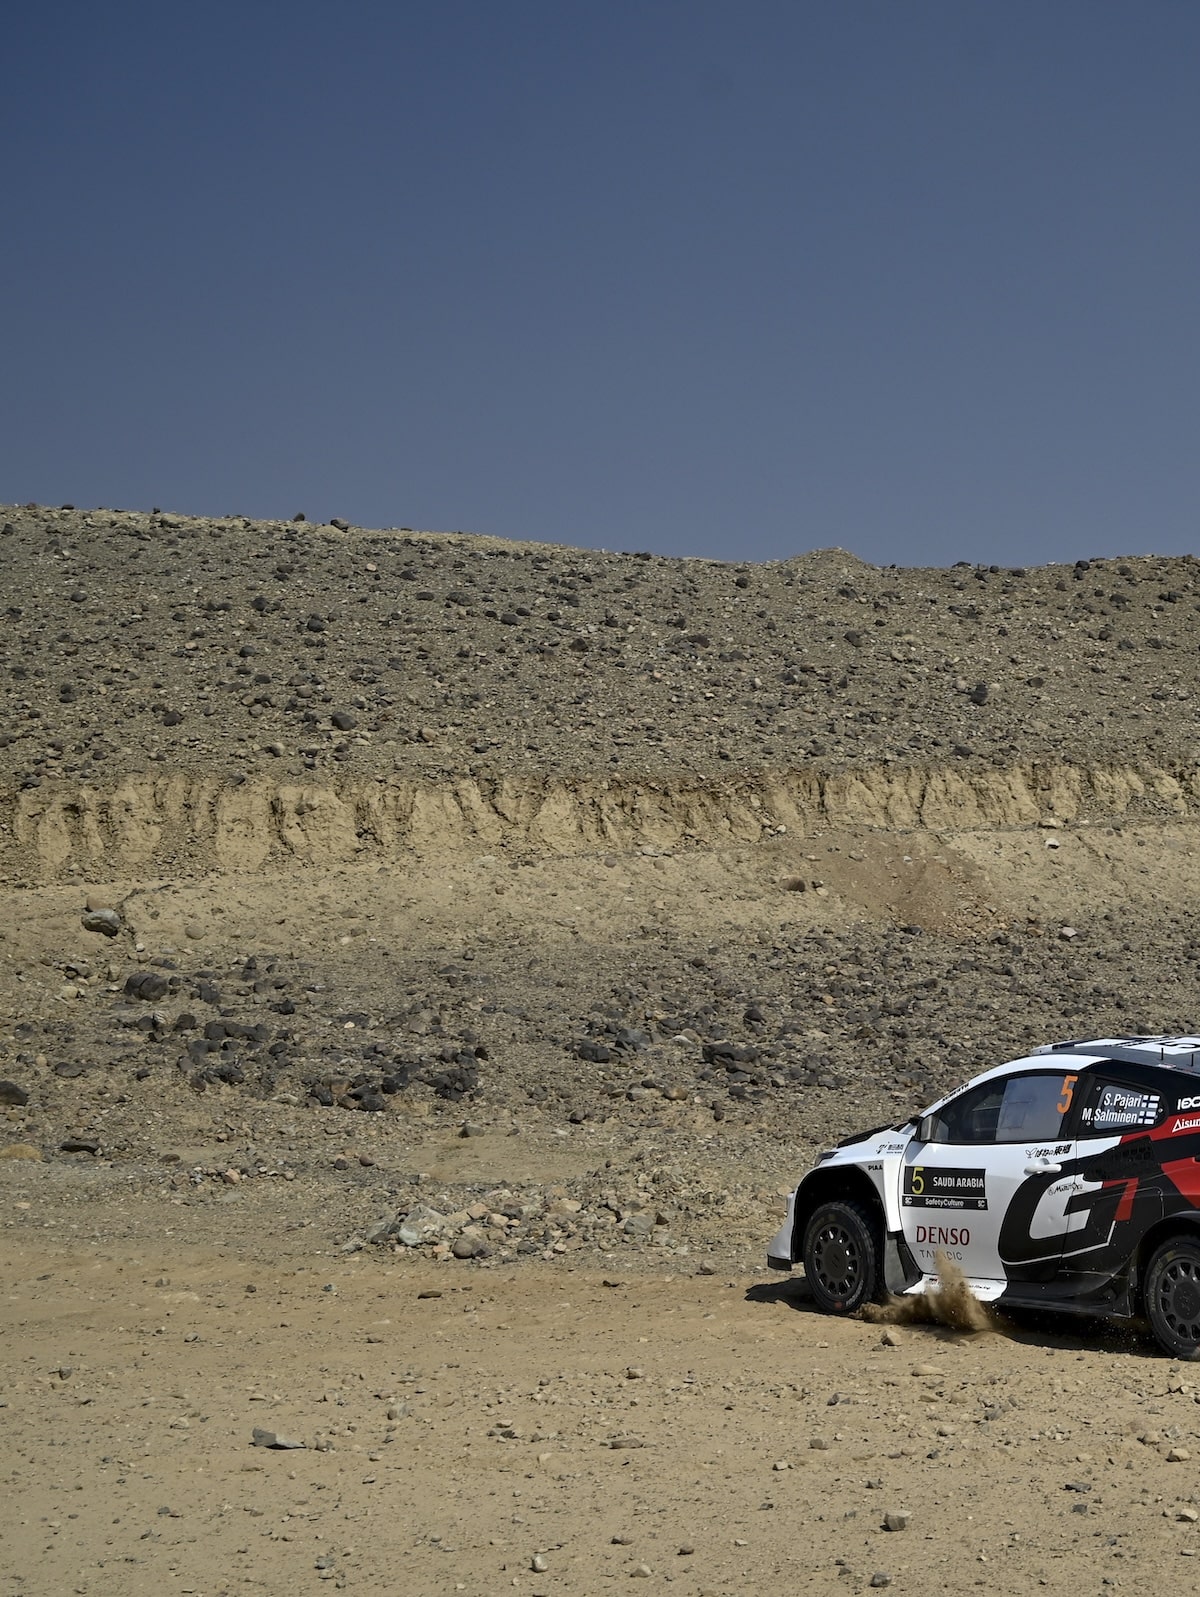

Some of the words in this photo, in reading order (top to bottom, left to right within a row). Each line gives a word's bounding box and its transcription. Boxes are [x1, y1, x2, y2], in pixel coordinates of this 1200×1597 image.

[1057, 1075, 1079, 1114] 5
[1103, 1092, 1143, 1109] S.Pajari
[1081, 1107, 1138, 1124] M.Salminen
[911, 1166, 925, 1195] 5
[933, 1176, 955, 1188] SAUDI
[956, 1177, 985, 1189] ARABIA
[925, 1198, 965, 1208] SafetyCulture
[916, 1225, 970, 1246] DENSO
